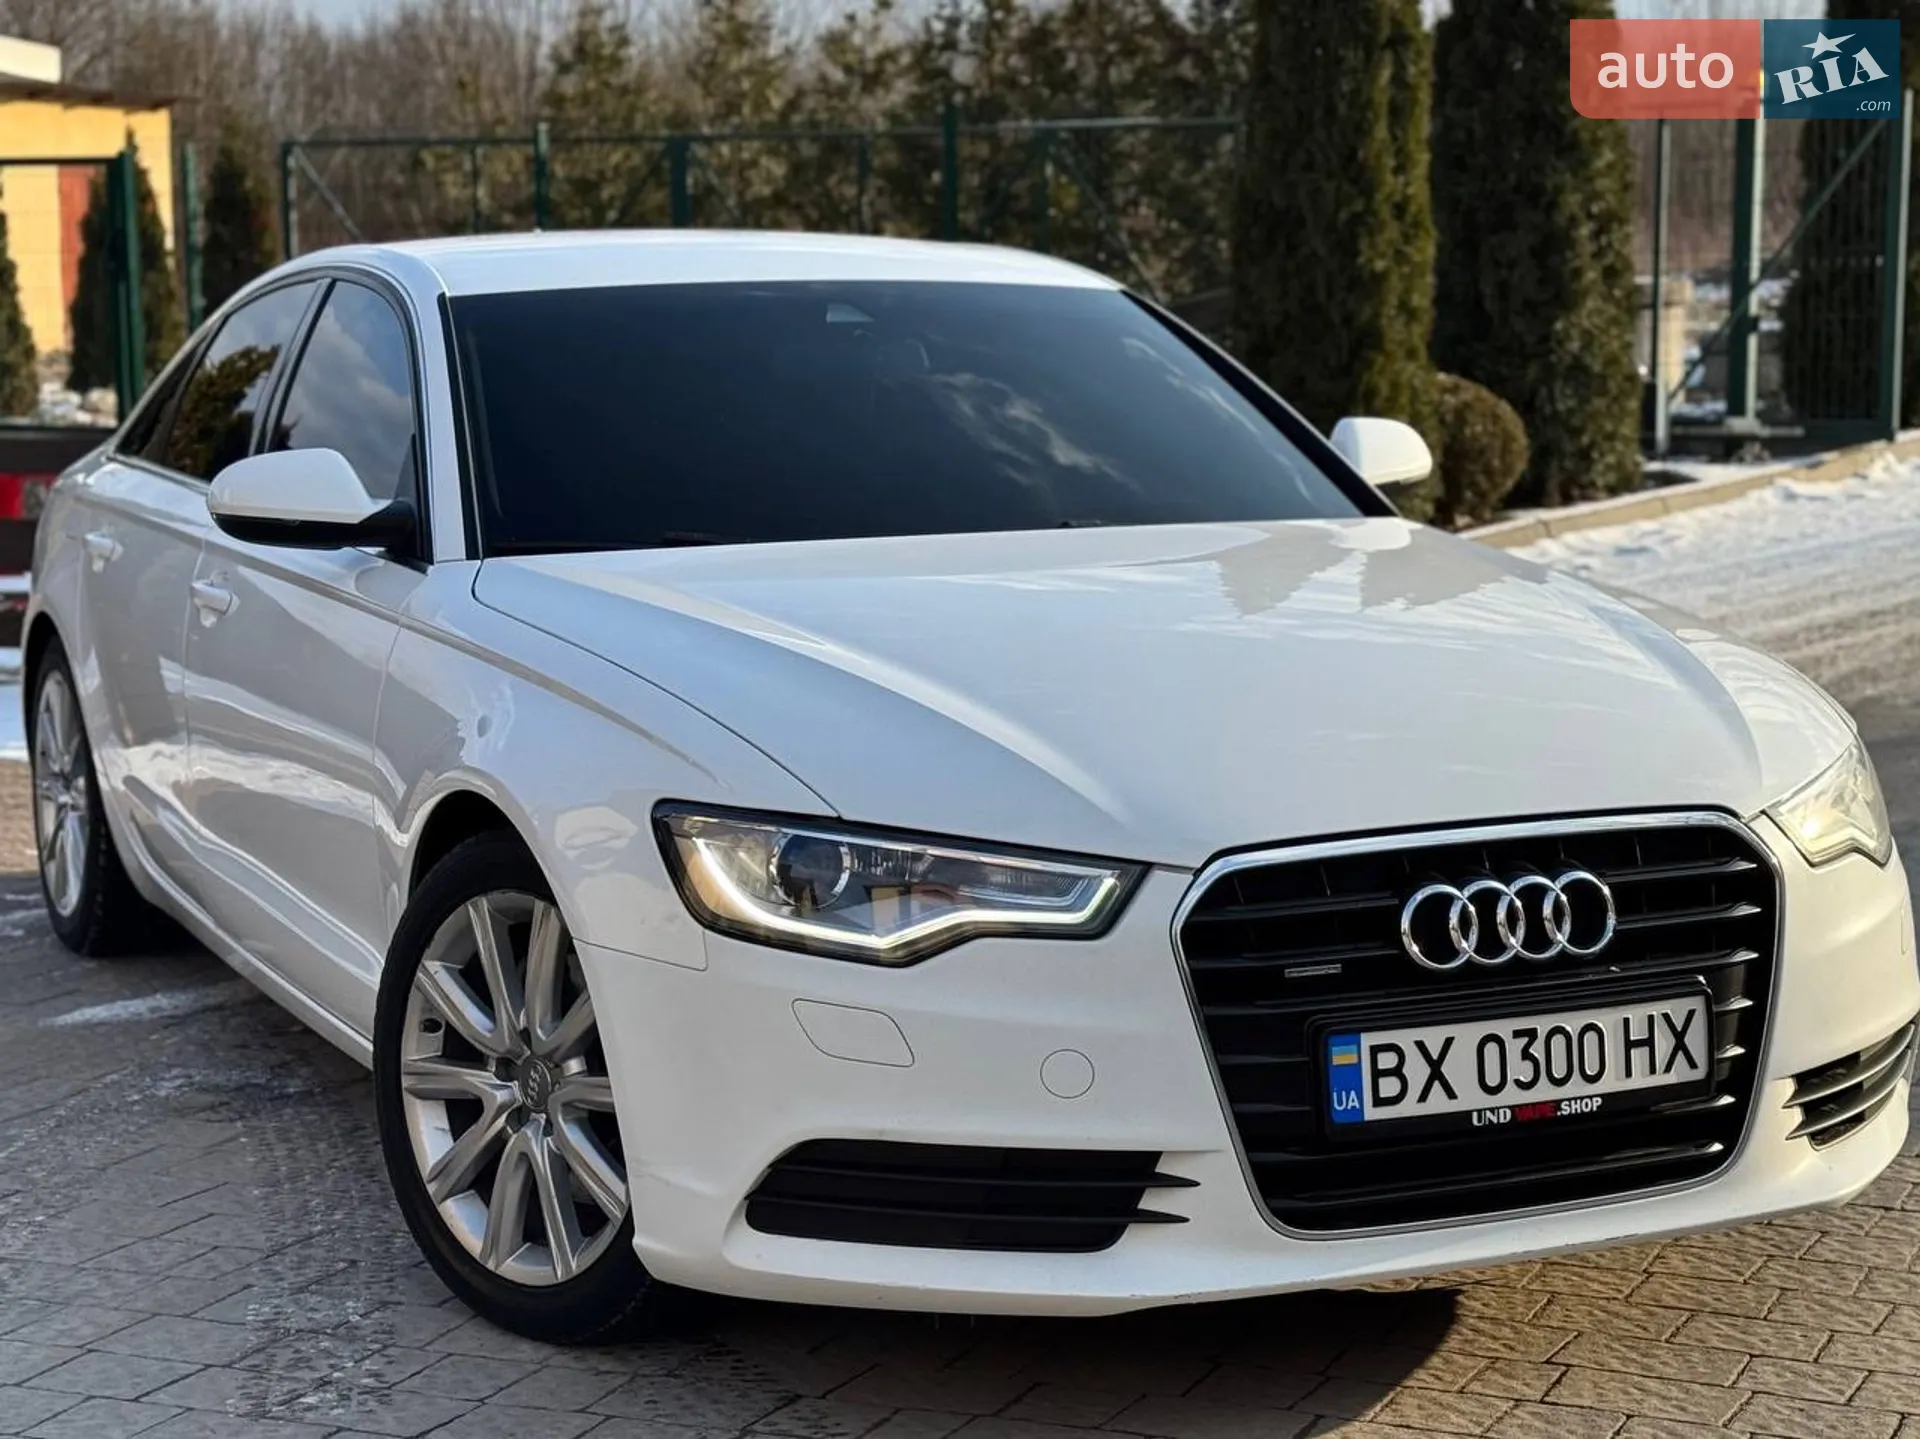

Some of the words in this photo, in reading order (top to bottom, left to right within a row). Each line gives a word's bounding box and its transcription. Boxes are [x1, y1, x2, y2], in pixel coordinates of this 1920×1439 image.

[1369, 1036, 1458, 1107] BX
[1476, 1022, 1606, 1095] 0300
[1623, 1008, 1699, 1078] HX
[1333, 1090, 1360, 1110] UA
[1471, 1107, 1512, 1126] UND
